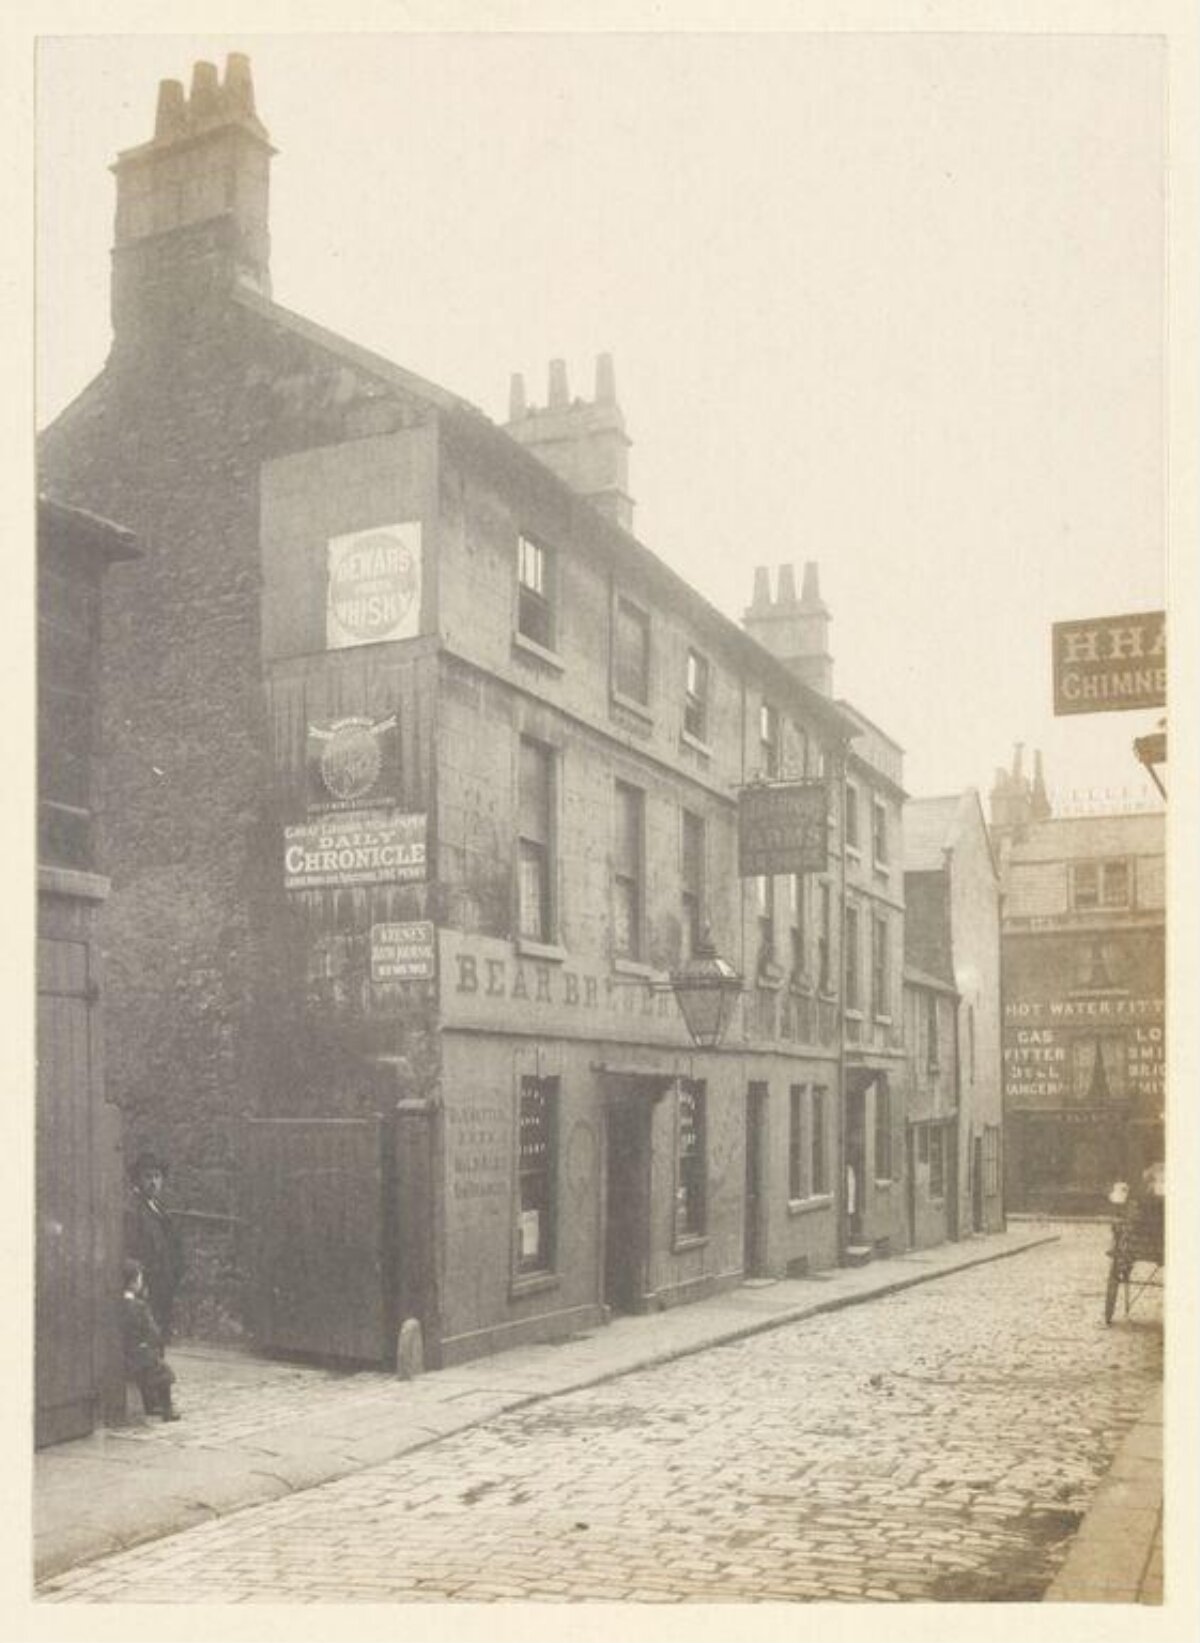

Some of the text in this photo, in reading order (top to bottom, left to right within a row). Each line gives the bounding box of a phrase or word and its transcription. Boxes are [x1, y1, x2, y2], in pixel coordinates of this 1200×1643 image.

[336, 591, 412, 626] WHISKY
[318, 829, 397, 850] DAILY
[285, 843, 426, 874] CHRONICLE
[456, 954, 551, 1003] BEAR
[1005, 1002, 1043, 1017] HOT
[1050, 1000, 1110, 1016] WATER
[1017, 1030, 1054, 1044] GAS
[1004, 1047, 1065, 1062] FITTER
